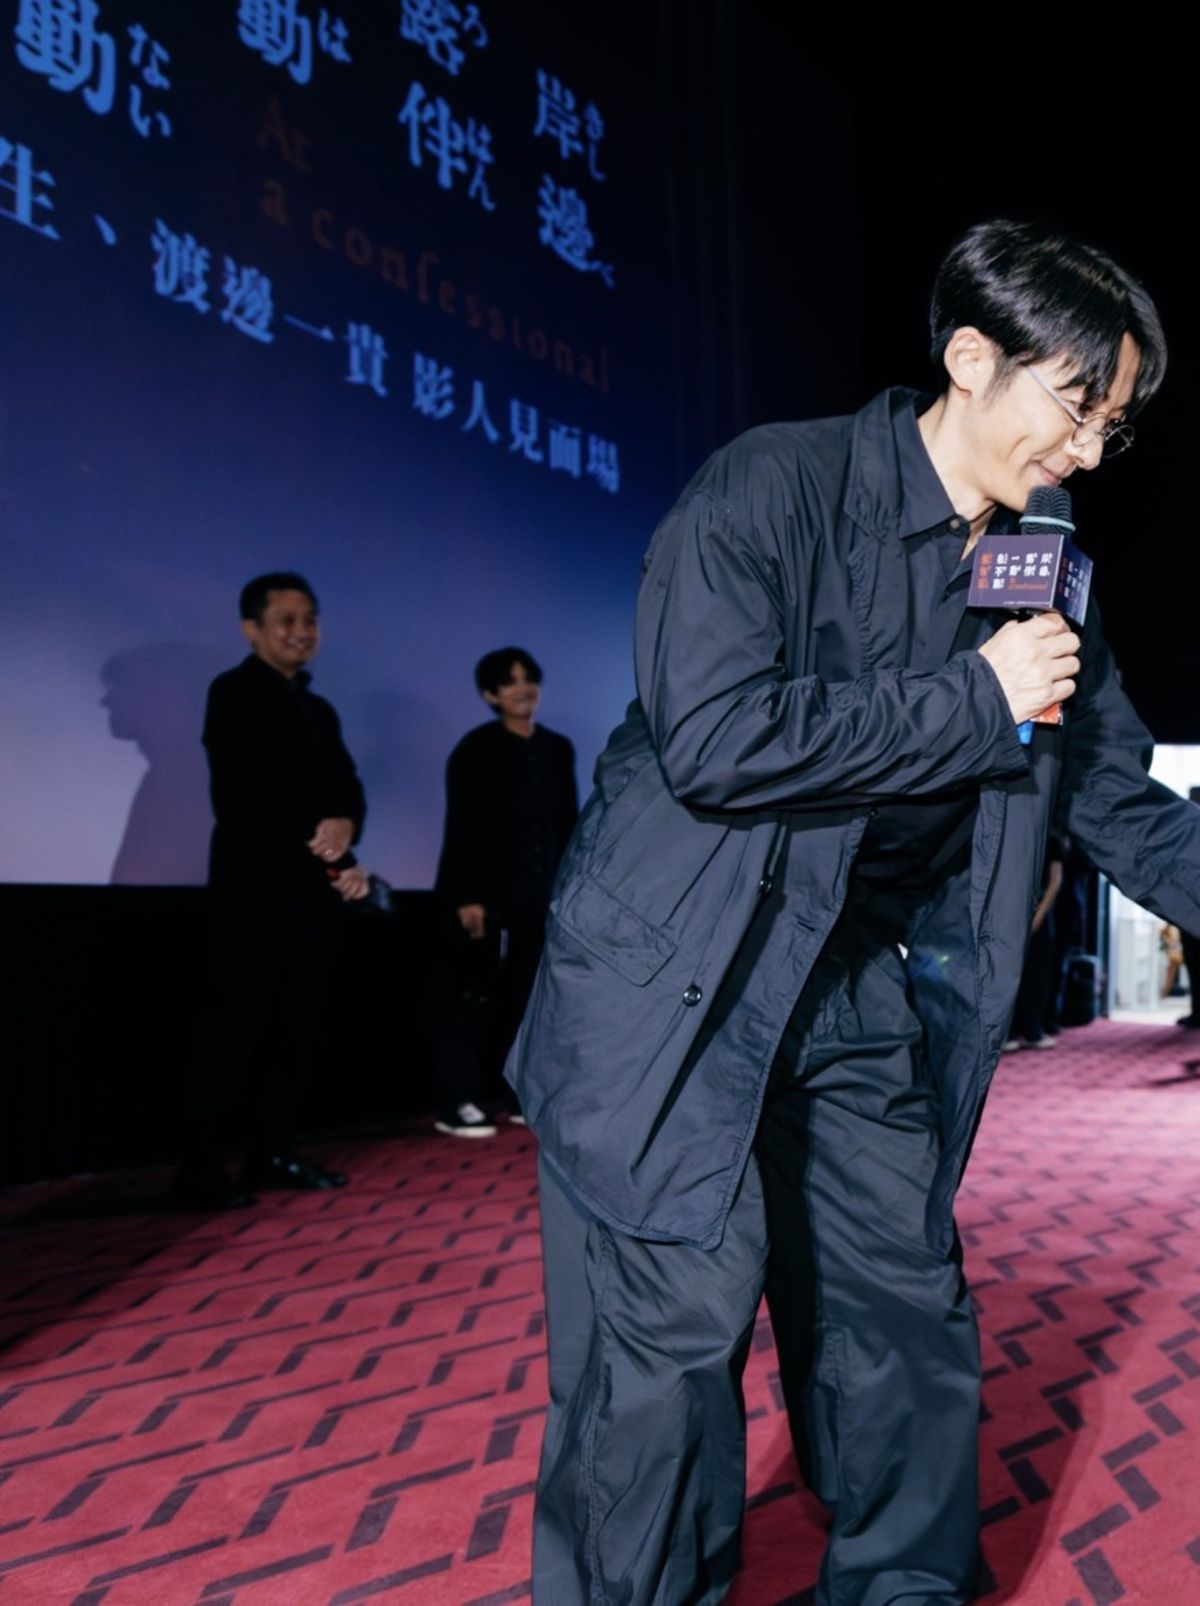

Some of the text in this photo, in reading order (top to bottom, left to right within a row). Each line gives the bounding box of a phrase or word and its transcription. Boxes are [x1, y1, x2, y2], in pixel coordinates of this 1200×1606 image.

[127, 23, 171, 138] ない
[317, 9, 352, 63] は
[311, 206, 610, 395] confessional
